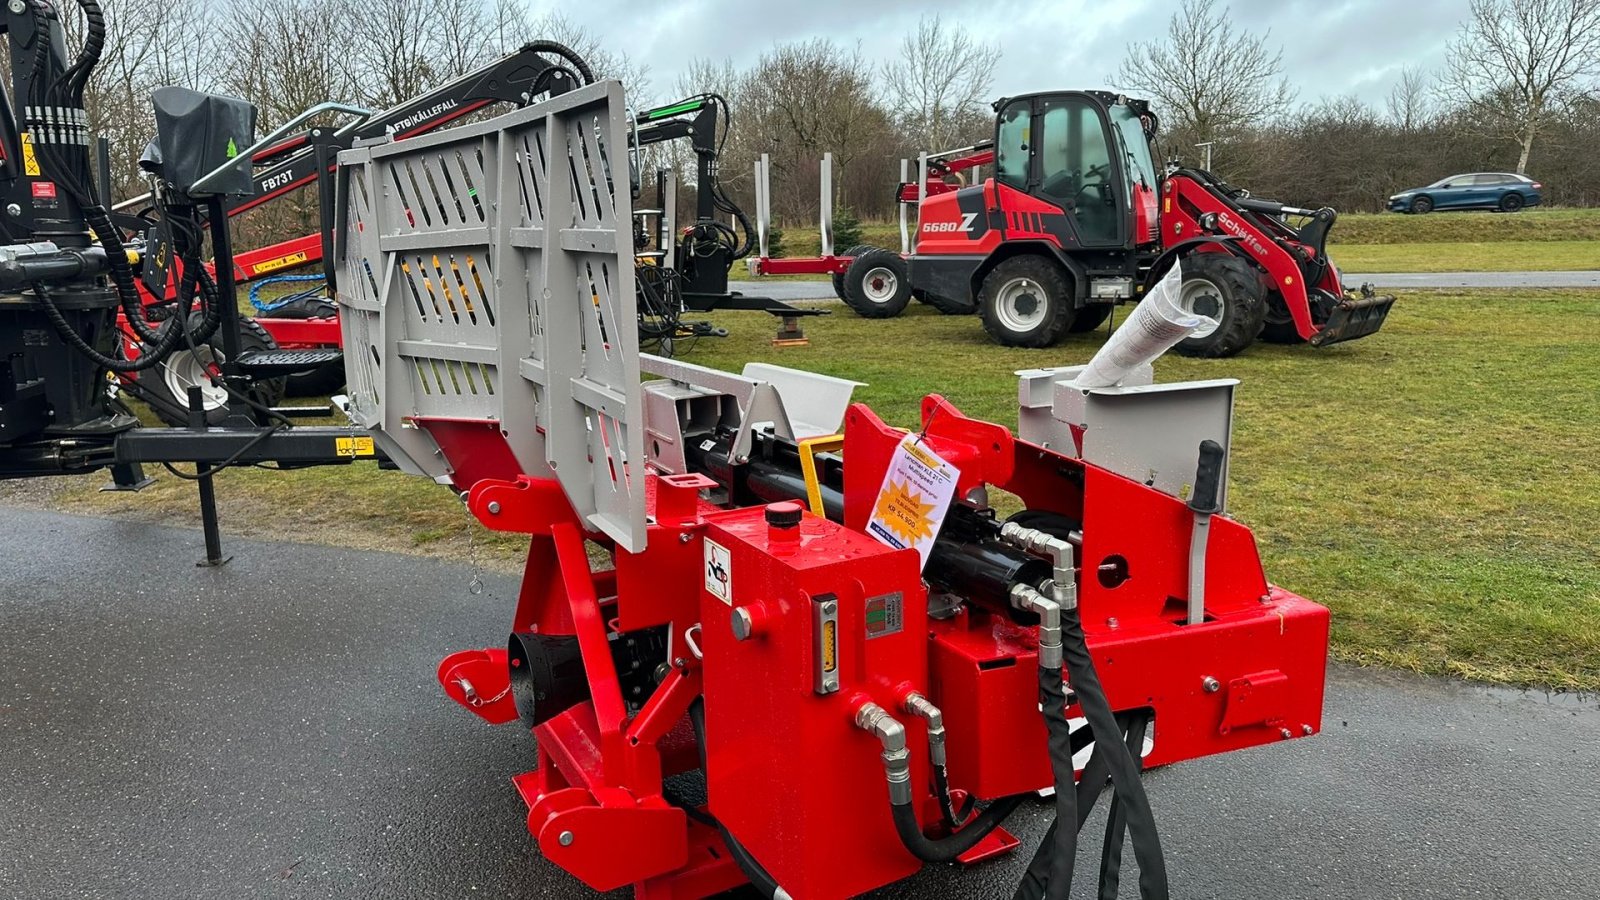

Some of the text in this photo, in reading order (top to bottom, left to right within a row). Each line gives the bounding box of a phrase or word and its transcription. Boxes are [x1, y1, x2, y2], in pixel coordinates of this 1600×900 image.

[261, 169, 293, 192] FB73T
[922, 221, 957, 232] 6680
[1218, 211, 1268, 255] Schäffer
[907, 465, 933, 485] Multispeed
